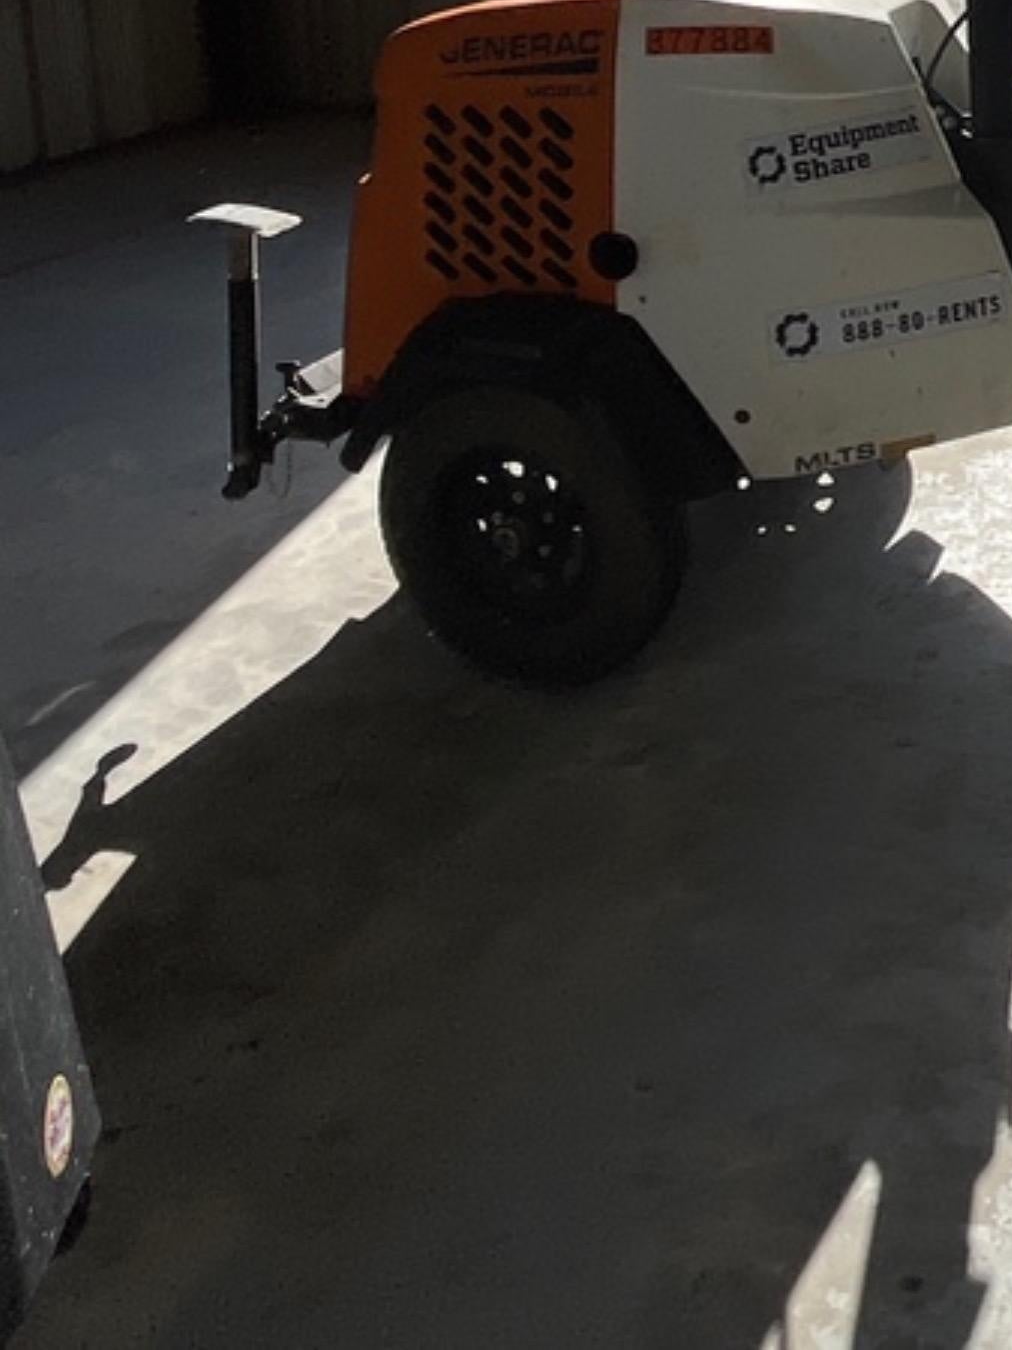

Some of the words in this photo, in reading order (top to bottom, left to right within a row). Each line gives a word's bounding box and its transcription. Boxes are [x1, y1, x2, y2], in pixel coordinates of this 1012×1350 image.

[788, 114, 921, 156] Equipment
[793, 152, 871, 182] Share
[842, 295, 1001, 343] 888-80-RENTS
[794, 441, 877, 473] MLTS
